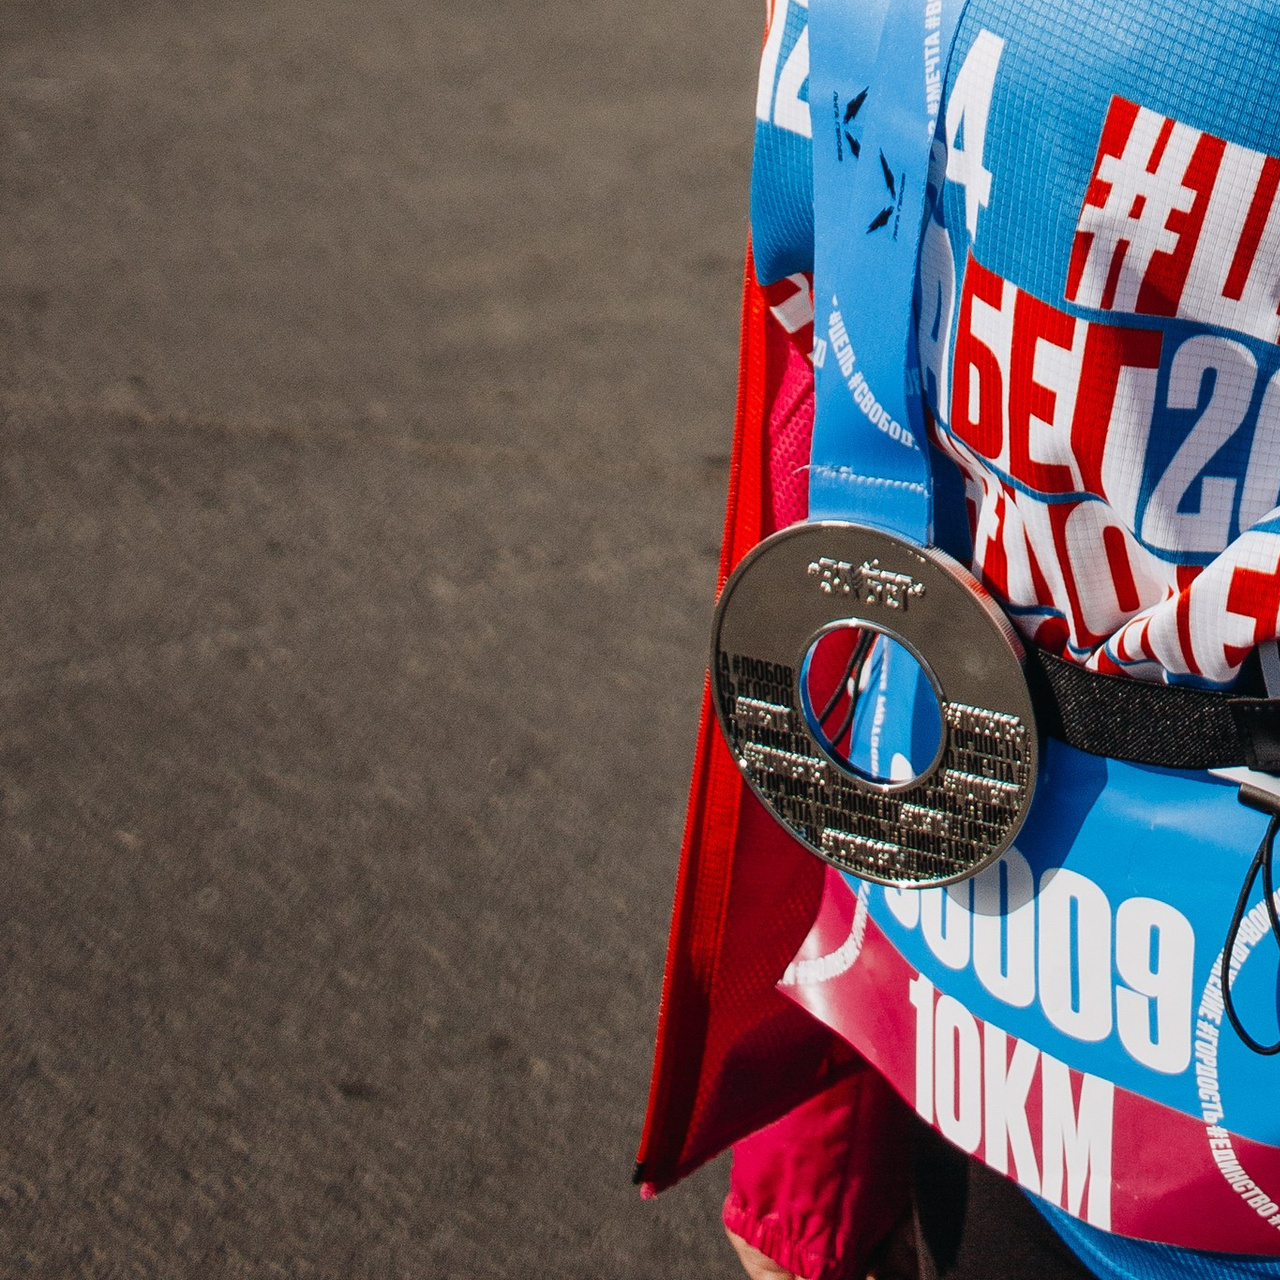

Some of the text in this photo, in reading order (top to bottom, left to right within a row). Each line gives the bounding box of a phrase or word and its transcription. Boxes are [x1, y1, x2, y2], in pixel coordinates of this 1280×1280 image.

[925, 30, 941, 115] #МЕЧТА
[828, 311, 920, 451] #ЦЕЛЬ #СВОБОД
[733, 654, 795, 688] #ЛЮБОВ
[1195, 1018, 1224, 1125] #ГОРДОСТЬ
[1206, 1124, 1279, 1218] #ЕДИНСТВО
